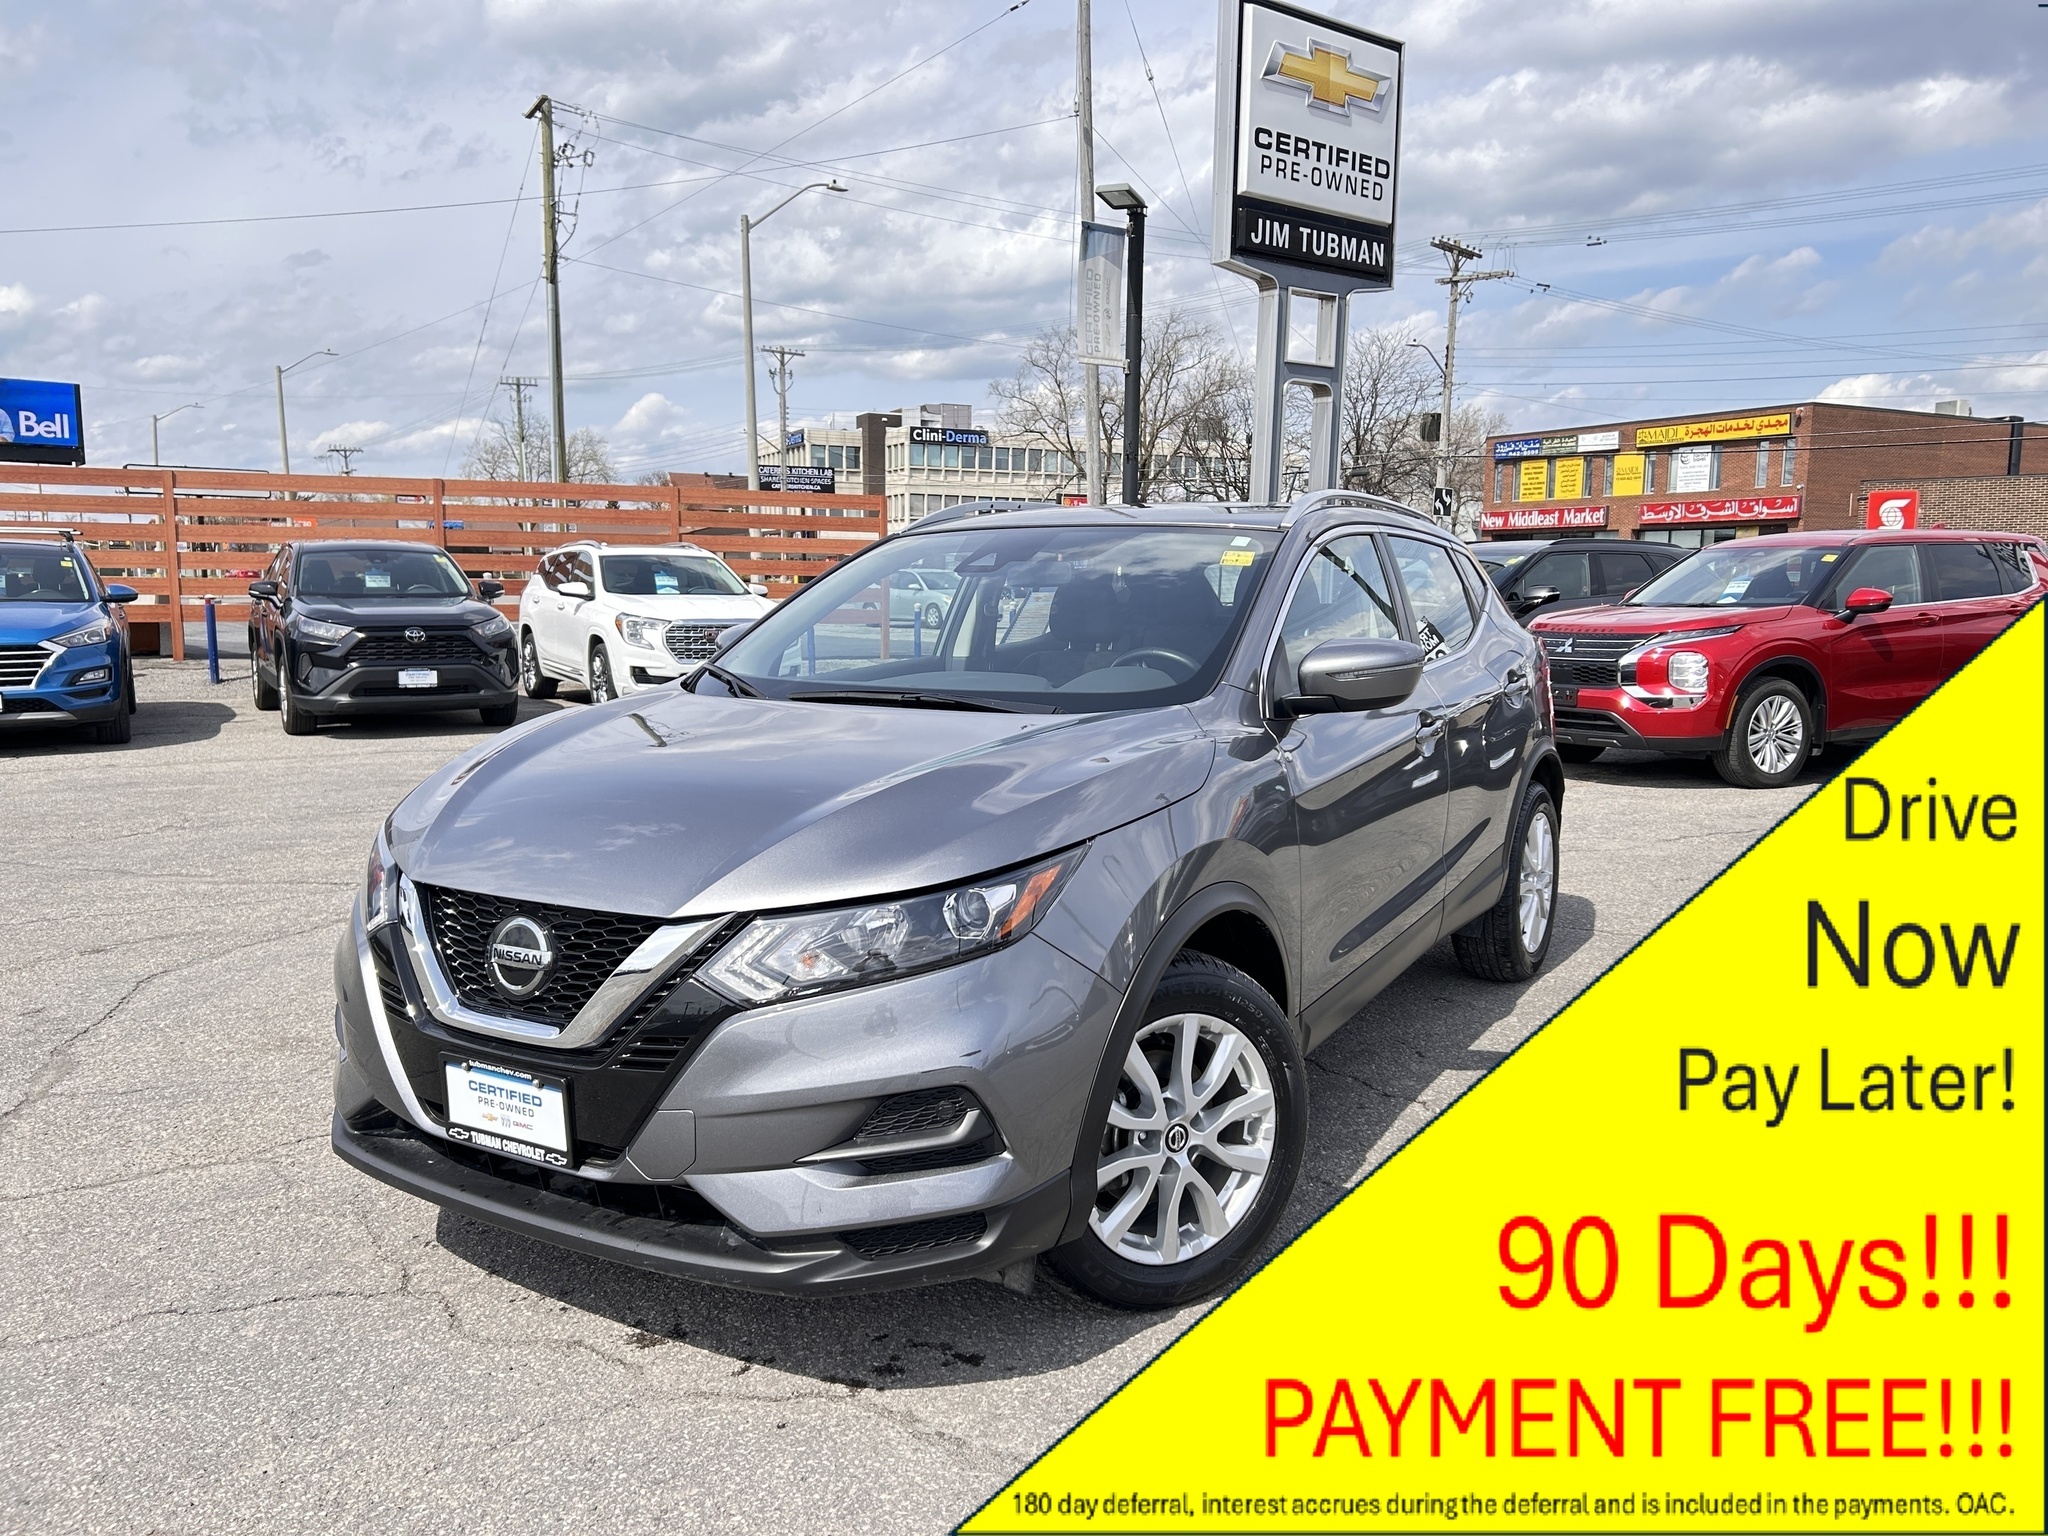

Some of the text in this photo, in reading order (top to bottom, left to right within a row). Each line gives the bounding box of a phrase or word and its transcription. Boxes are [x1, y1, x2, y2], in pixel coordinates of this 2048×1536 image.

[1254, 127, 1390, 180] CERTIFIED
[1261, 154, 1383, 201] PRE-OWNED
[1251, 218, 1385, 267] JIM TUBMAN
[1085, 268, 1094, 356] CERTIFIED
[1093, 273, 1102, 353] PRE-OWNED
[18, 410, 70, 439] Bell
[912, 428, 987, 444] Clini-Derma
[791, 467, 818, 475] KITCHEN
[820, 469, 833, 477] LAB
[1481, 508, 1605, 528] New Middleast Market
[493, 947, 542, 966] NISSAN
[469, 1059, 532, 1080] tubmanchev.com
[468, 1080, 543, 1107] CERTIFIED
[478, 1096, 535, 1118] PRE-OWNED
[512, 1120, 534, 1131] GMC
[471, 1131, 545, 1161] TUBMAN CHEVROLET
